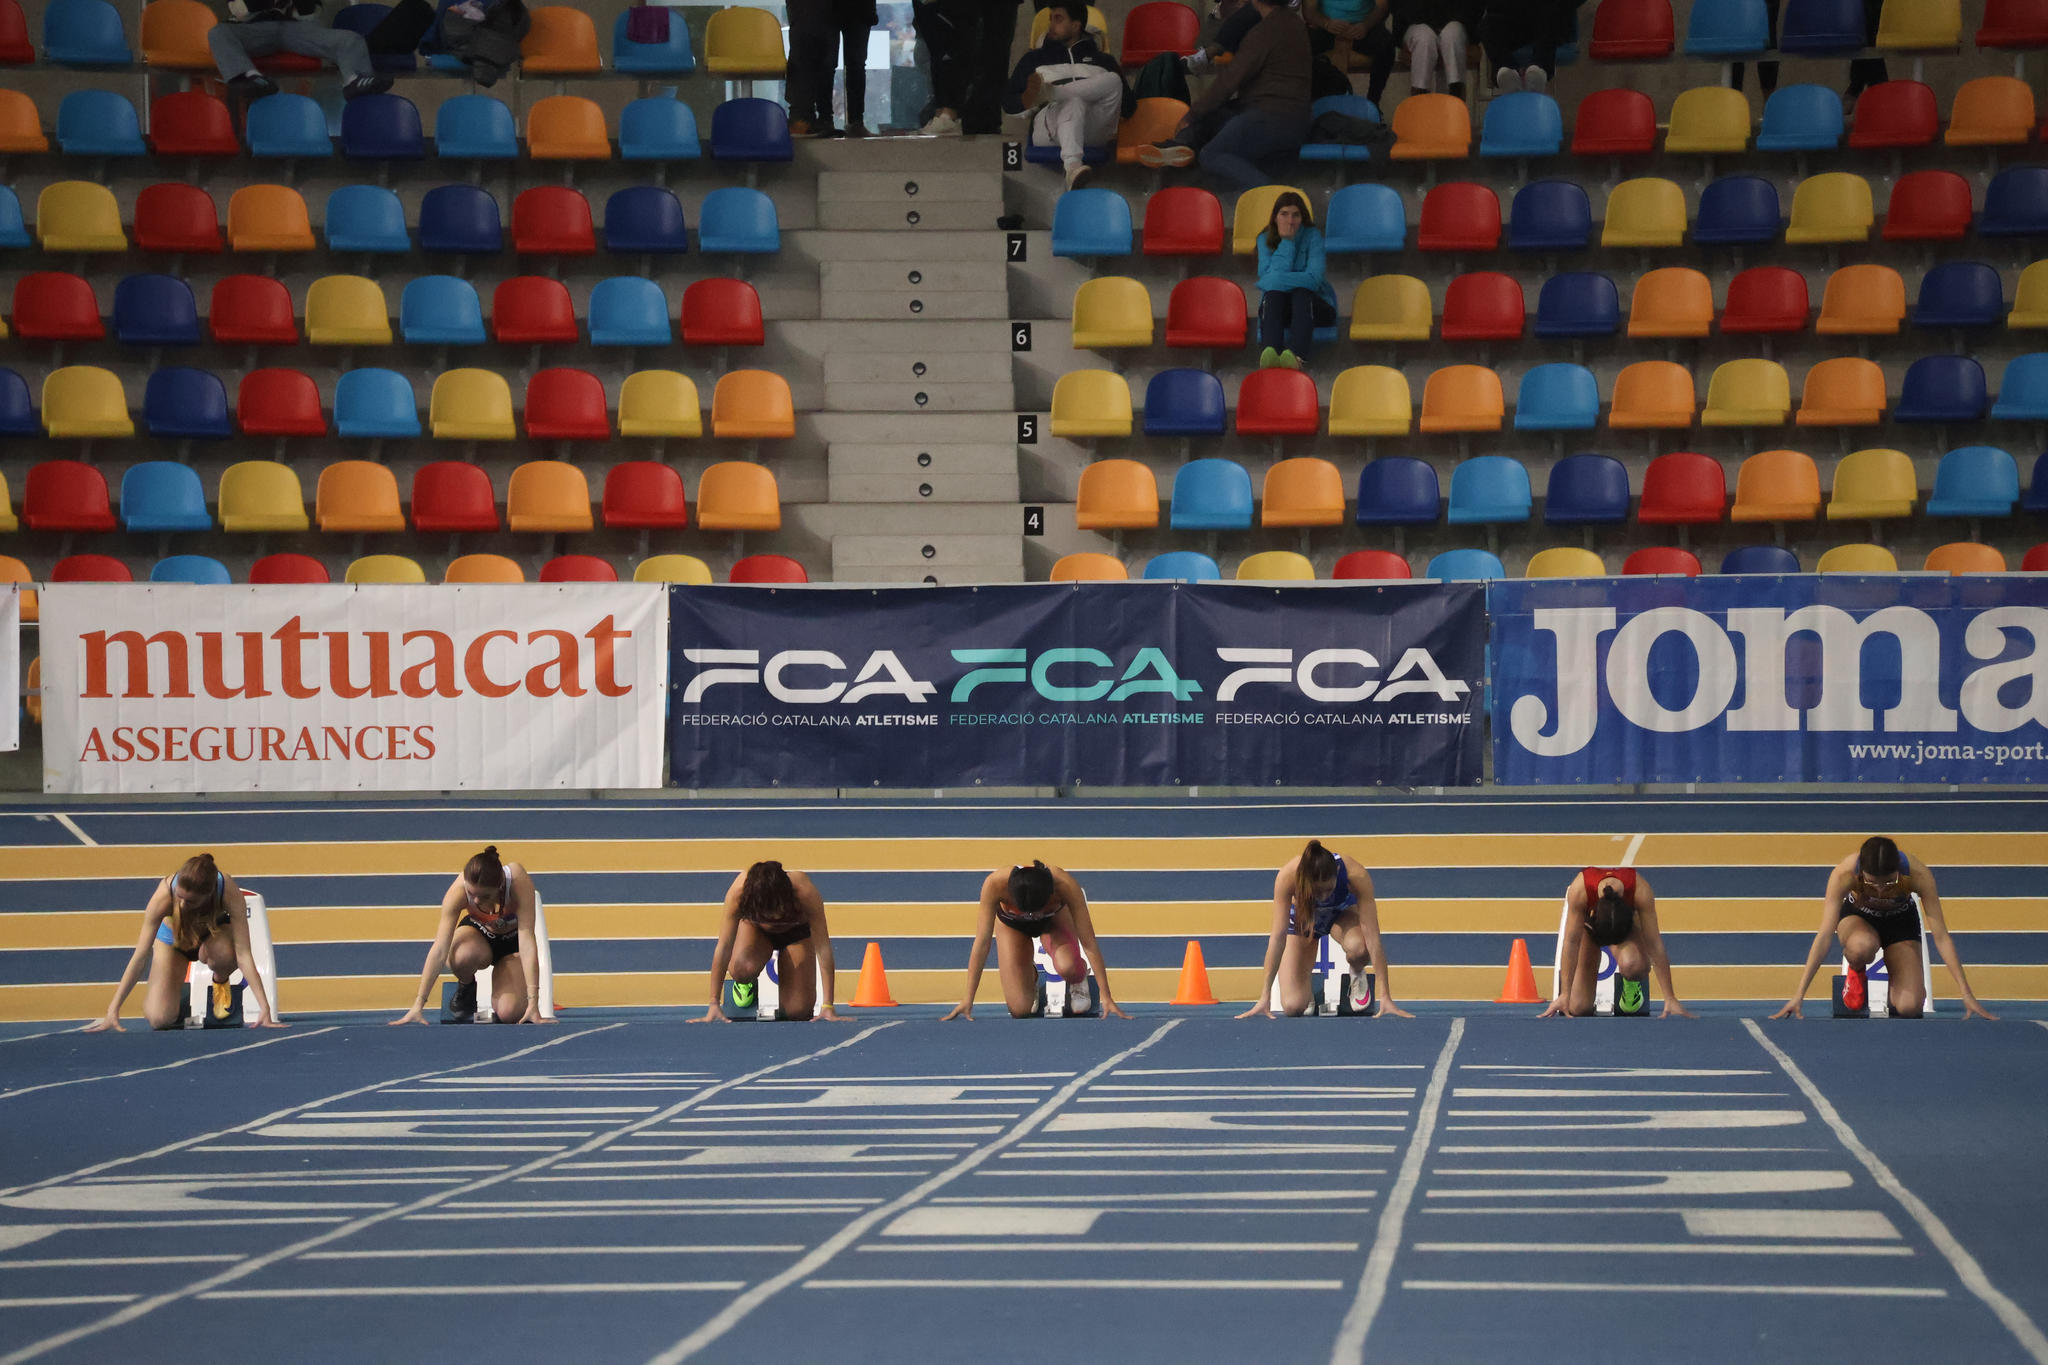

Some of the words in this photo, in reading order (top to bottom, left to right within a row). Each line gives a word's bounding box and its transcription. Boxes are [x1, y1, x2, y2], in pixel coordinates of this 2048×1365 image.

[1007, 149, 1018, 165] 8
[1011, 240, 1022, 256] 7
[1016, 329, 1027, 345] 6
[1022, 421, 1033, 437] 5
[1028, 513, 1040, 529] 4
[79, 614, 633, 700] mutuacat
[683, 648, 938, 703] FCA
[950, 647, 1203, 702] FCA
[1216, 647, 1471, 702] FCA
[682, 712, 768, 726] FEDERACIÓ
[771, 714, 851, 726] CATALANA
[855, 714, 939, 726] ATLETISME
[950, 711, 1035, 725] FEDERACIÓ
[1038, 713, 1118, 724] CATALANA
[1122, 712, 1204, 724] ATLETISME
[1215, 711, 1300, 725] FEDERACIÓ
[1304, 713, 1384, 725] CATALANA
[1387, 713, 1471, 725] ATLETISME
[79, 725, 437, 763] ASSEGURANCES
